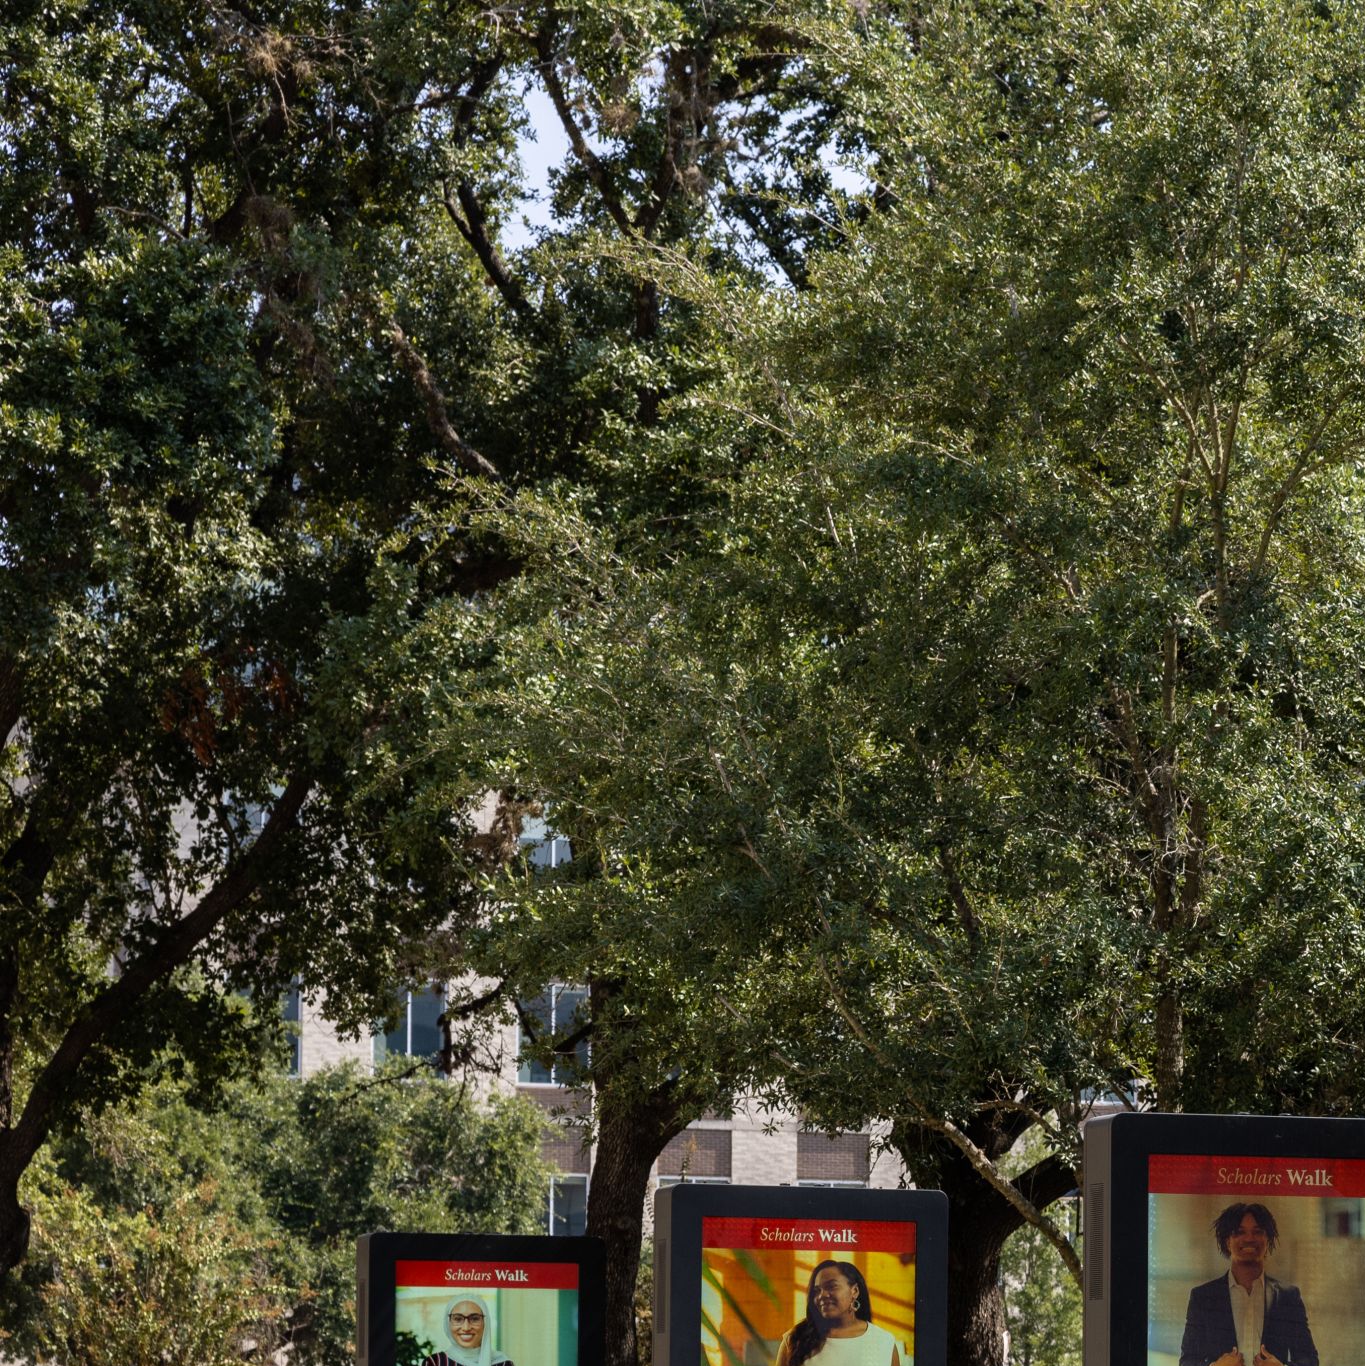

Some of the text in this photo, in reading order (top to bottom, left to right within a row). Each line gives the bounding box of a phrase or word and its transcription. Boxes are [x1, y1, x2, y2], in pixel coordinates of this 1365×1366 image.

[1217, 1168, 1333, 1186] Scholars Walk
[760, 1227, 858, 1243] Scholars Walk
[444, 1268, 529, 1282] Scholars Walk
